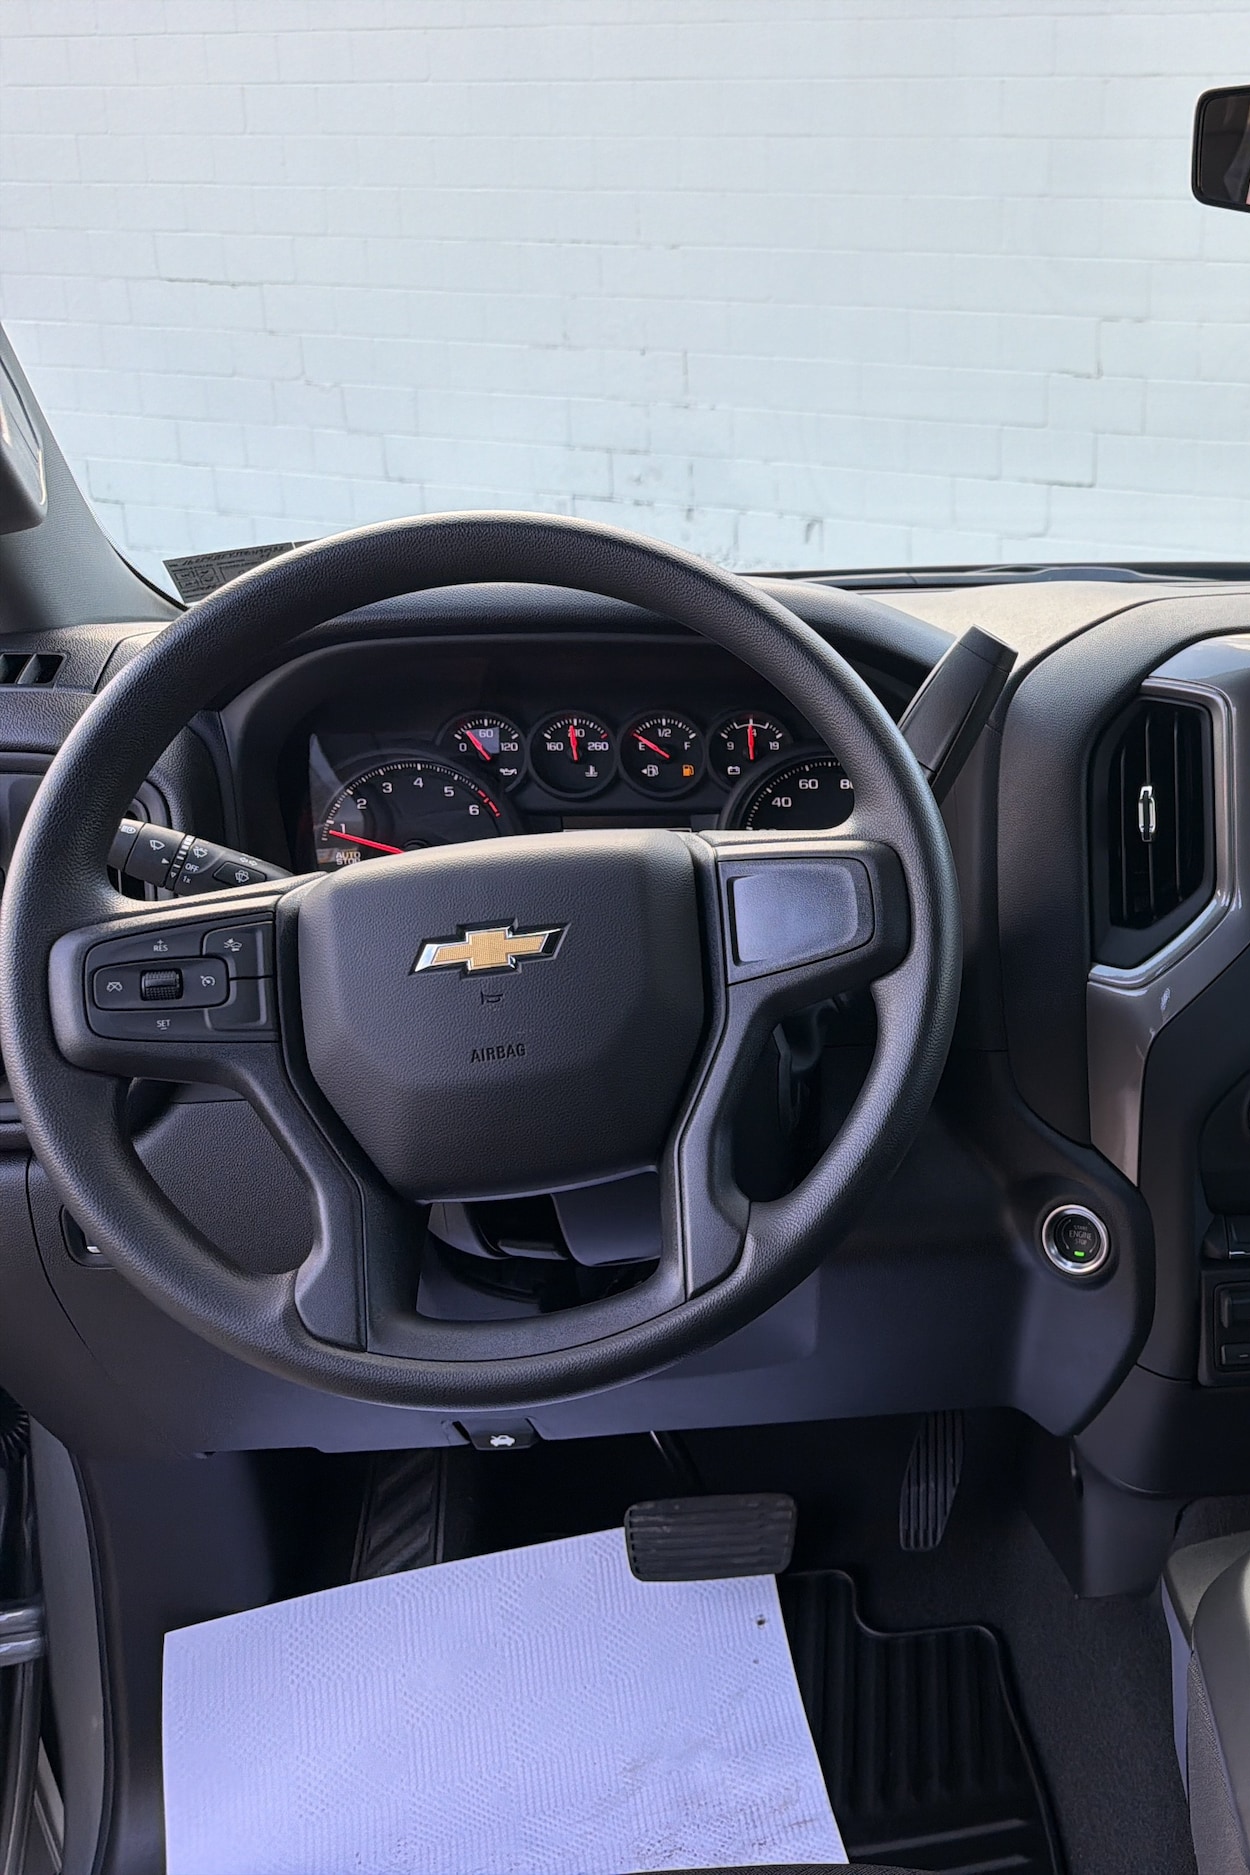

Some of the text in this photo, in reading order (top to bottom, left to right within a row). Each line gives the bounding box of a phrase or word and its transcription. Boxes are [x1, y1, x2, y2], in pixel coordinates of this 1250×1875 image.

[478, 729, 494, 738] 60
[657, 728, 672, 738] 1/2
[459, 743, 467, 751] 0
[500, 742, 518, 751] 120
[546, 742, 564, 751] 160
[587, 742, 609, 750] 260
[638, 742, 646, 751] E
[684, 742, 691, 750] F
[727, 742, 734, 750] 9
[769, 742, 780, 750] 19
[413, 777, 424, 788] 4
[798, 779, 819, 789] 60
[382, 782, 393, 794] 3
[444, 786, 455, 797] 5
[356, 798, 367, 809] 2
[771, 797, 792, 808] 40
[469, 805, 480, 816] 6
[340, 823, 346, 833] 1
[185, 862, 200, 873] OFF
[182, 876, 191, 884] 1x
[153, 944, 168, 952] RES
[470, 1043, 526, 1063] AIRBAG
[1069, 1230, 1092, 1240] ENGINE
